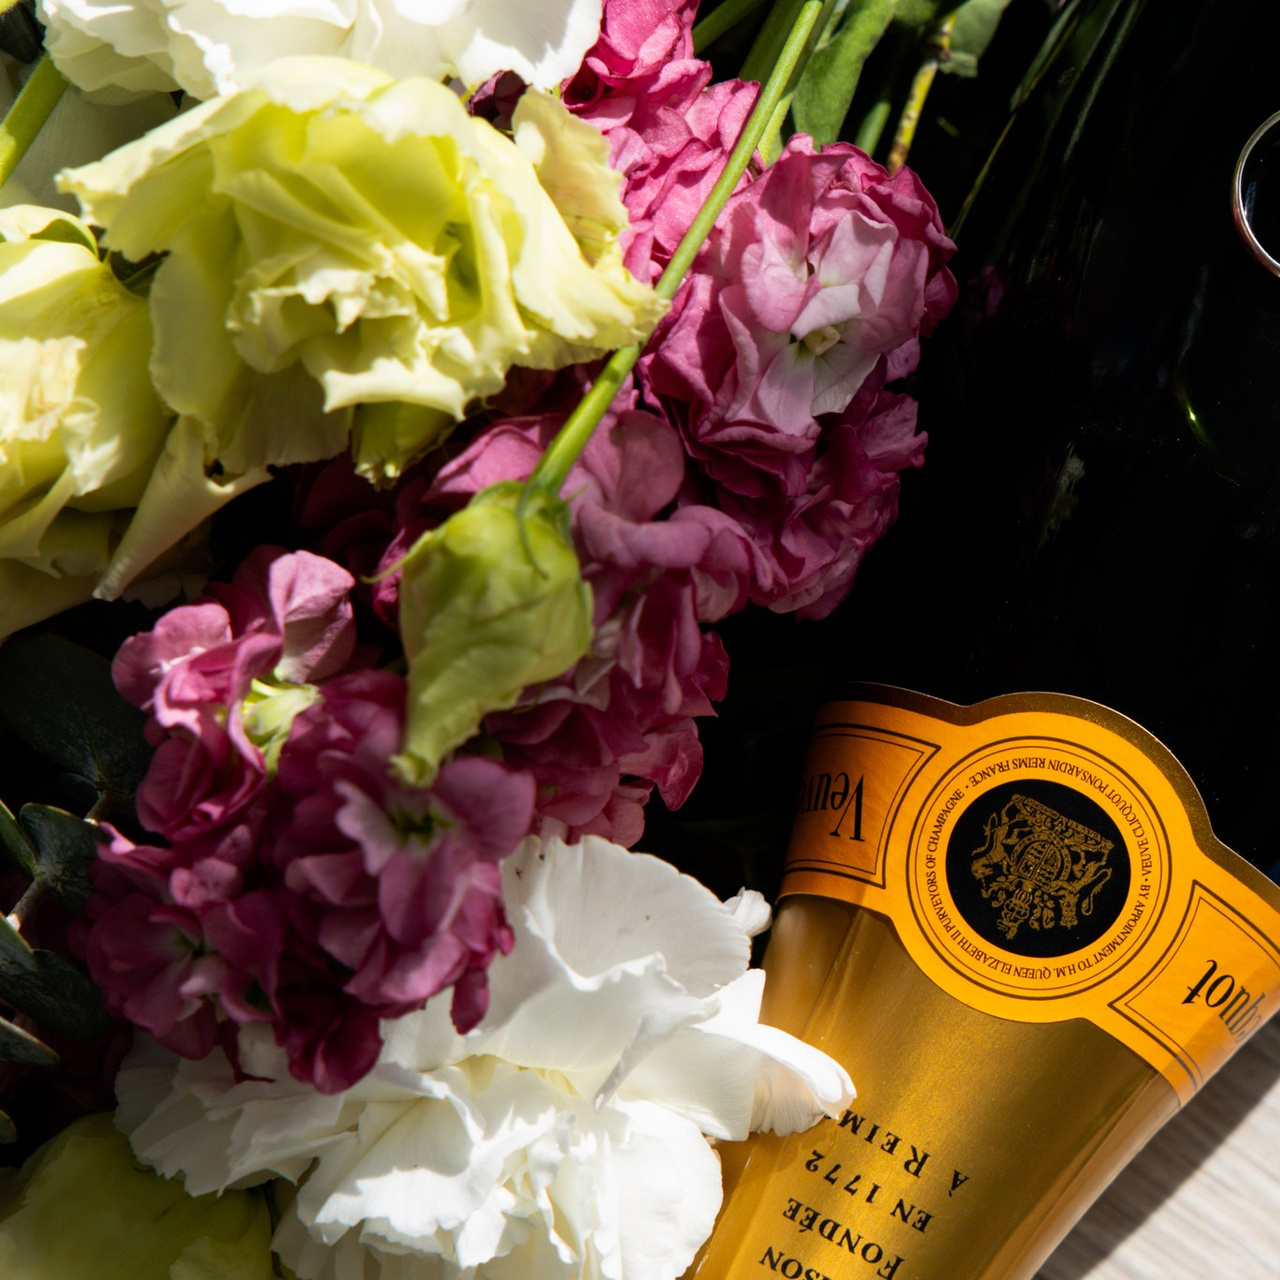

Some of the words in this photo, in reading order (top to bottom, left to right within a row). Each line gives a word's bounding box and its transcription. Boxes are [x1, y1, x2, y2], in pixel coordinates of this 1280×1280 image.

[969, 760, 1010, 787] FRANCE
[1012, 757, 1046, 772] REIMS
[1047, 758, 1109, 794] PONSARDIN
[801, 772, 865, 842] Veuv
[927, 789, 965, 852] CHAMPAGNE
[1105, 790, 1146, 838] CLICQUOT
[926, 853, 937, 869] OF
[1139, 836, 1153, 878] VEUVE
[926, 871, 956, 933] PURVEYORS
[1138, 883, 1151, 901] BY
[1095, 900, 1146, 963] APPOINTMENT
[957, 934, 1012, 974] ELIZABETH
[1013, 966, 1051, 980] QUEEN
[1053, 965, 1077, 978] H.M.
[1077, 958, 1094, 973] TO
[1181, 959, 1266, 1043] cquot
[824, 1107, 931, 1178] REIM
[804, 1148, 881, 1205] 1772
[948, 1169, 970, 1197] À
[889, 1198, 935, 1234] EN
